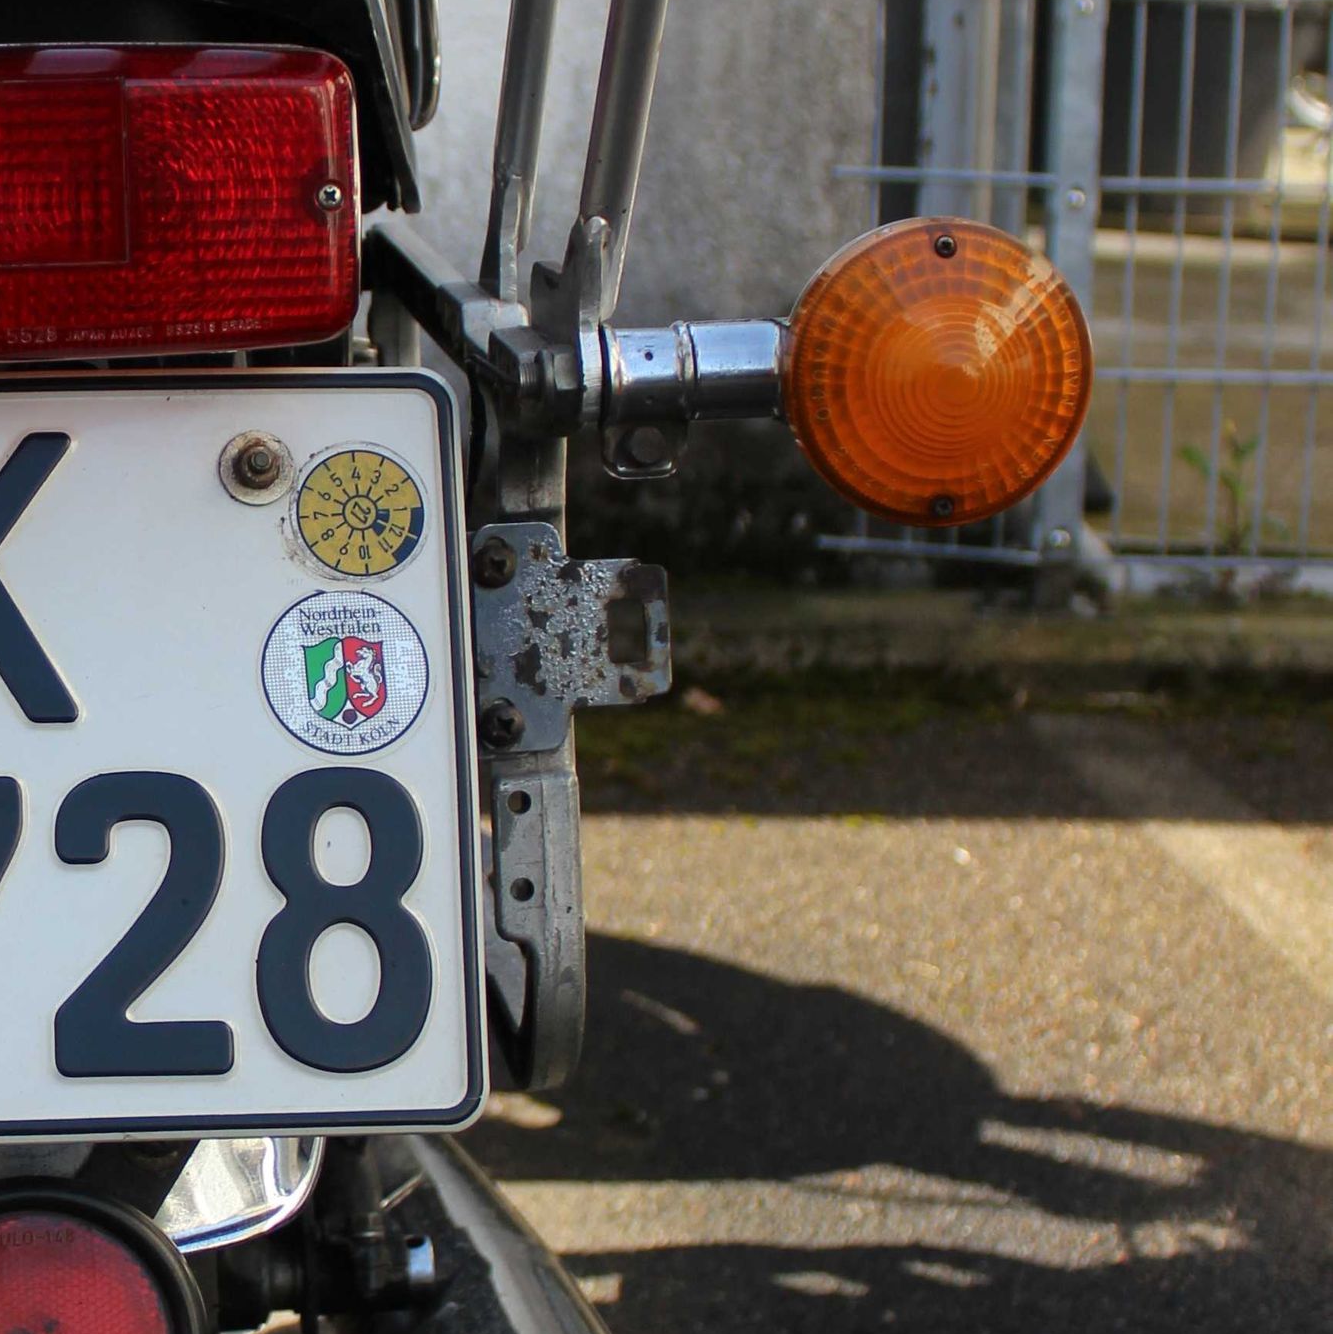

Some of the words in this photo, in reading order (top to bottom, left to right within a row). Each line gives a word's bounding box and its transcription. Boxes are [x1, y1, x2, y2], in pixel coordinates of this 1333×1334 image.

[330, 473, 343, 487] 5
[351, 466, 361, 481] 4
[370, 470, 382, 484] 3
[317, 490, 331, 501] 6
[384, 483, 399, 497] 2
[321, 528, 335, 541] 8
[388, 523, 406, 538] 12
[339, 541, 350, 555] 9
[358, 544, 372, 560] 10
[377, 537, 394, 553] 11
[299, 605, 382, 622] Nordrhein-
[299, 620, 382, 636] Westfalen
[302, 720, 353, 747] STADT
[358, 717, 400, 746] KÖLN
